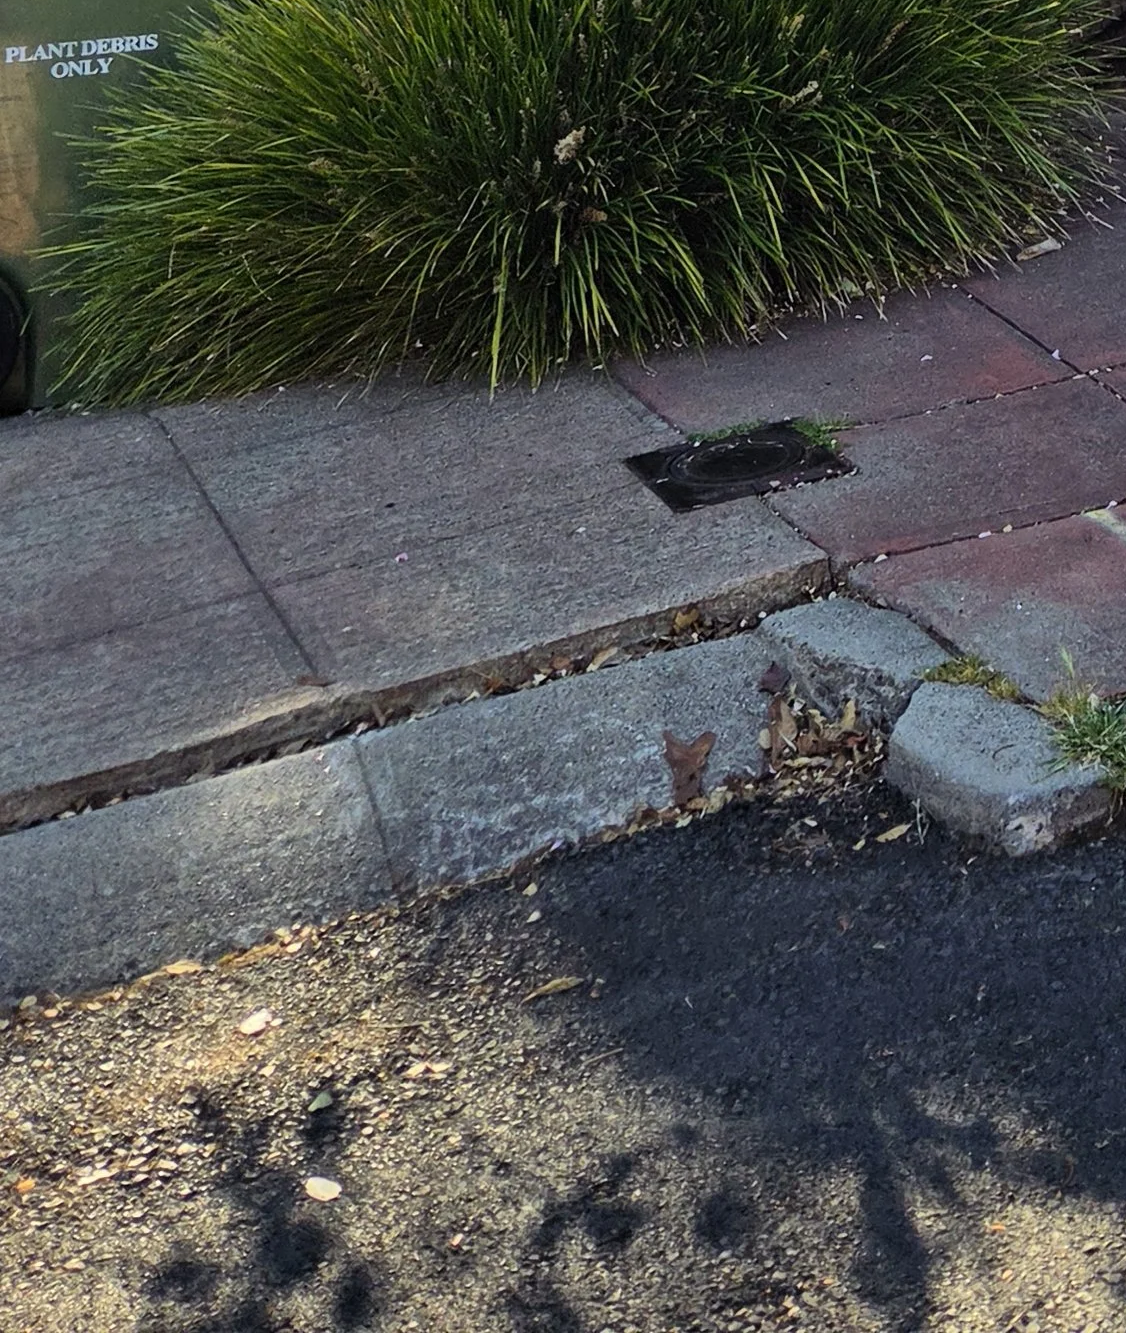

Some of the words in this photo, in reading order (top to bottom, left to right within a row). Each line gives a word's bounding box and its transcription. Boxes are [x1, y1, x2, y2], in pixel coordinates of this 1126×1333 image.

[5, 41, 78, 63] PLANT
[80, 33, 159, 57] DEBRIS
[50, 57, 113, 79] ONLY
